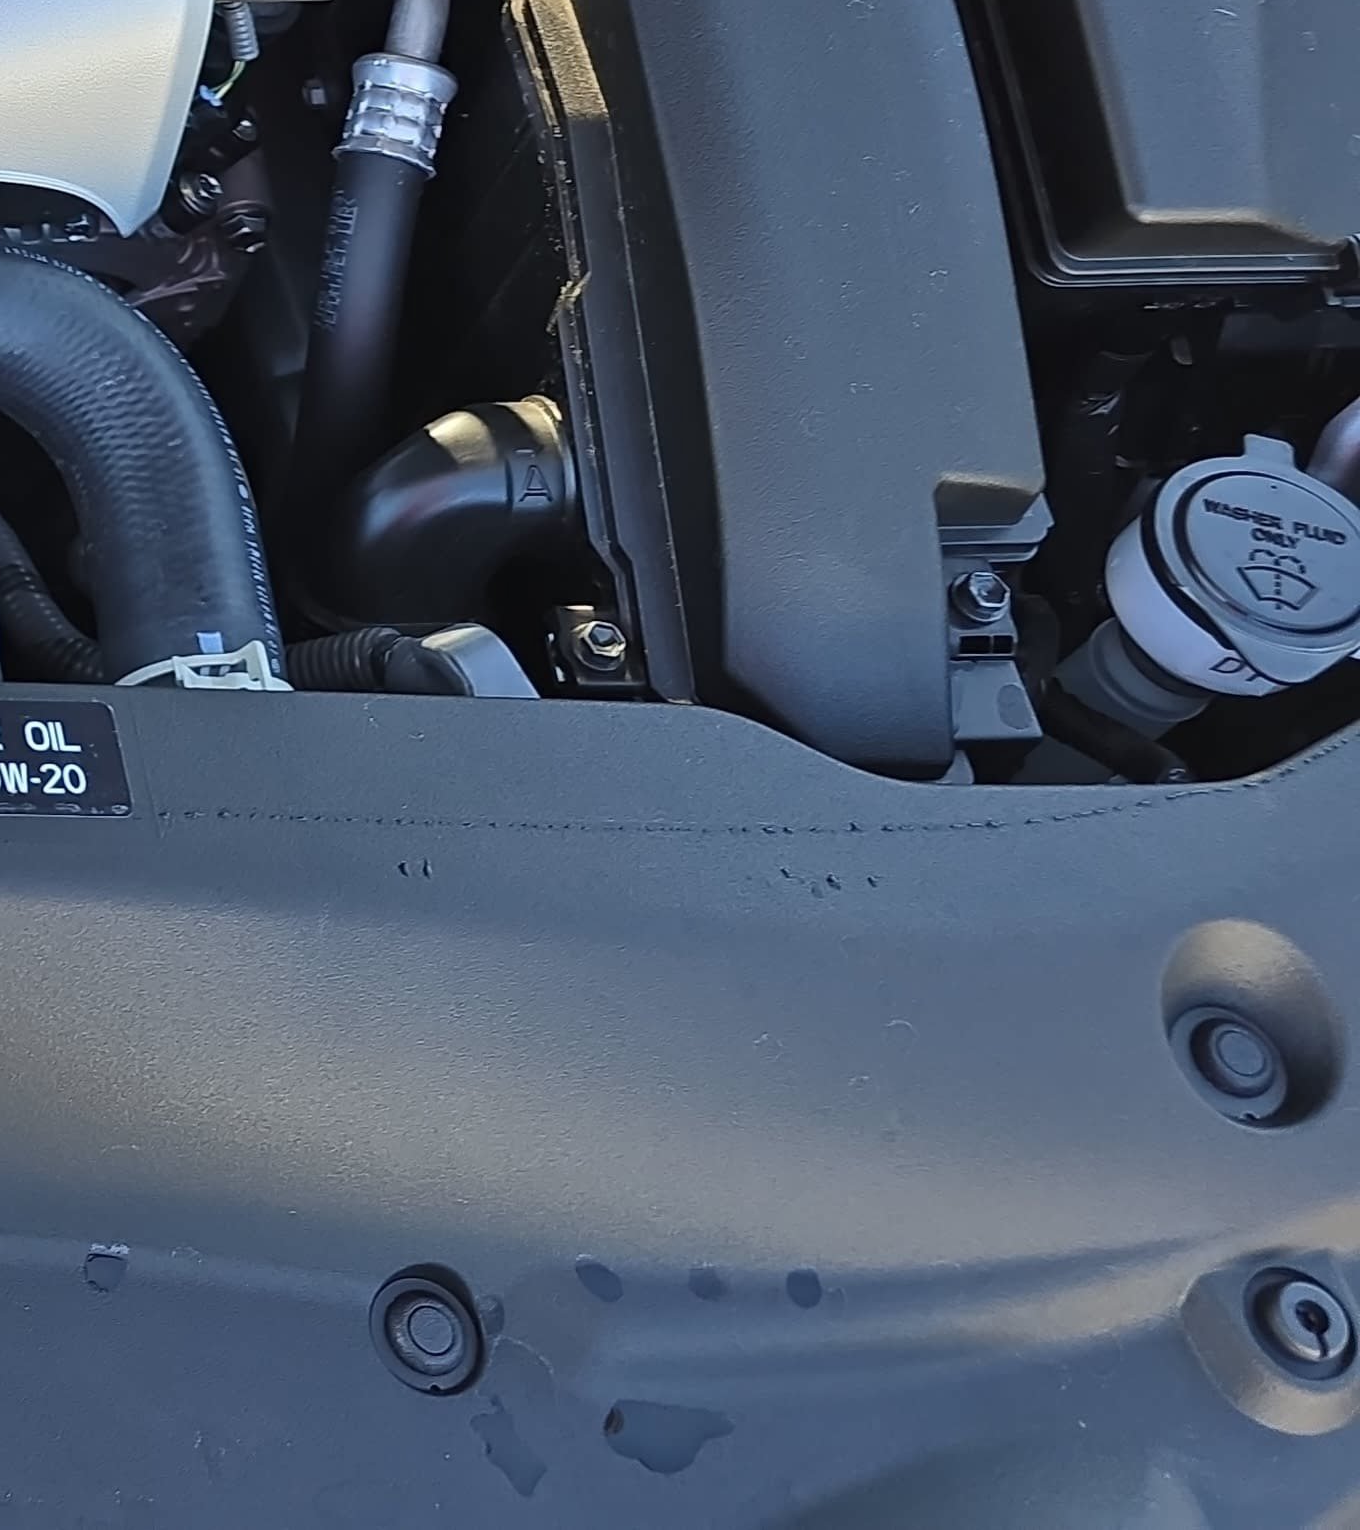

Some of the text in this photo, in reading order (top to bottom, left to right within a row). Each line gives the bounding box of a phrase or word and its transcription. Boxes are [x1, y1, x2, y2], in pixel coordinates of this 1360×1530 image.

[518, 464, 554, 503] A
[1202, 497, 1348, 546] WASHER FLUID
[1250, 527, 1301, 550] ONLY
[24, 720, 83, 753] OIL
